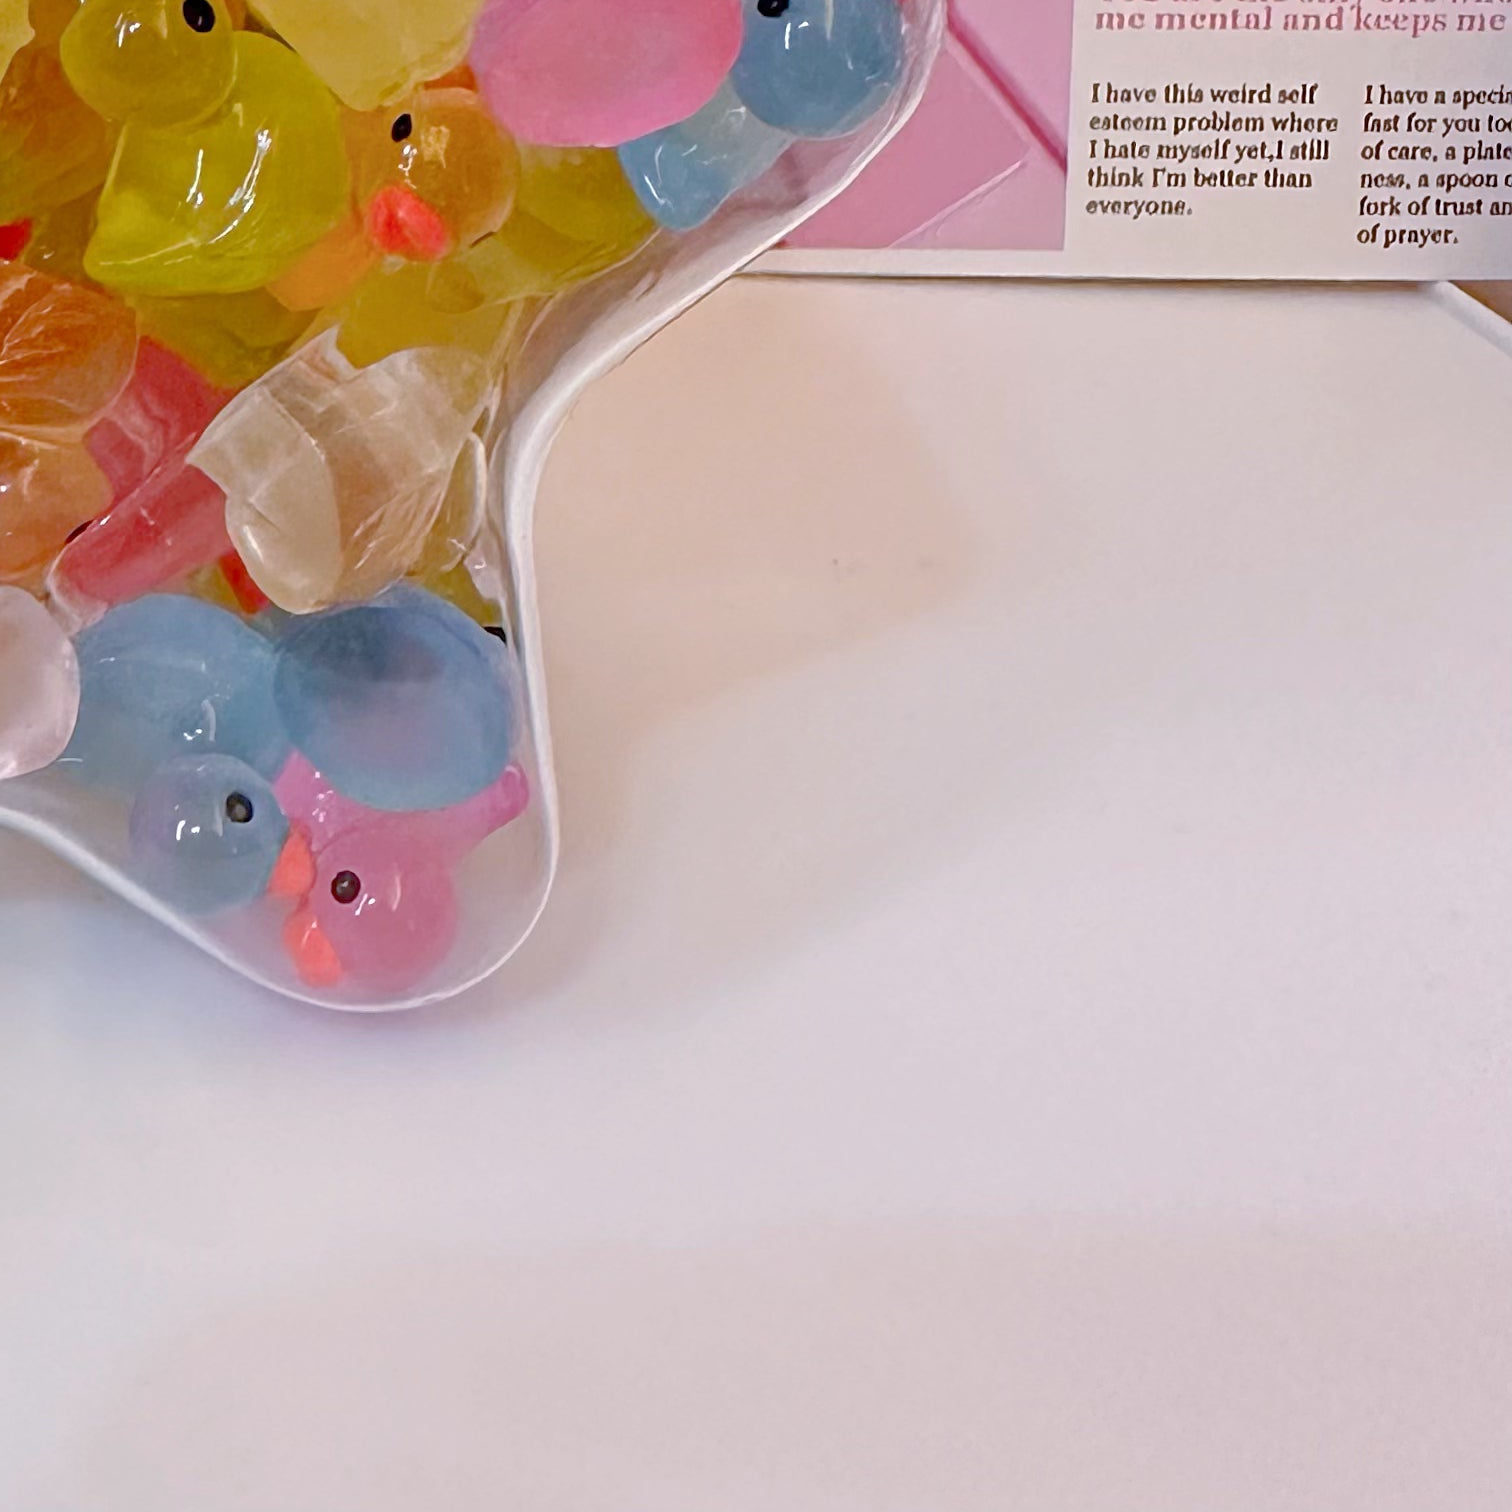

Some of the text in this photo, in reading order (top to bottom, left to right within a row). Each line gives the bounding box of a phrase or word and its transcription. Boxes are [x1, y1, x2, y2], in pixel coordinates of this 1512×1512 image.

[1095, 5, 1507, 37] me mental and keeps me
[1091, 82, 1318, 103] I have this weird self
[1089, 111, 1338, 135] esteem problem where
[1363, 112, 1400, 132] fast
[1406, 111, 1437, 132] for
[1441, 117, 1480, 137] you
[1089, 139, 1097, 159] I
[1104, 139, 1150, 159] hate
[1156, 138, 1231, 164] myself
[1290, 139, 1330, 160] still
[1087, 166, 1312, 188] think I'm better than
[1085, 199, 1192, 219] everyone.
[1356, 223, 1458, 248] of prayer.
